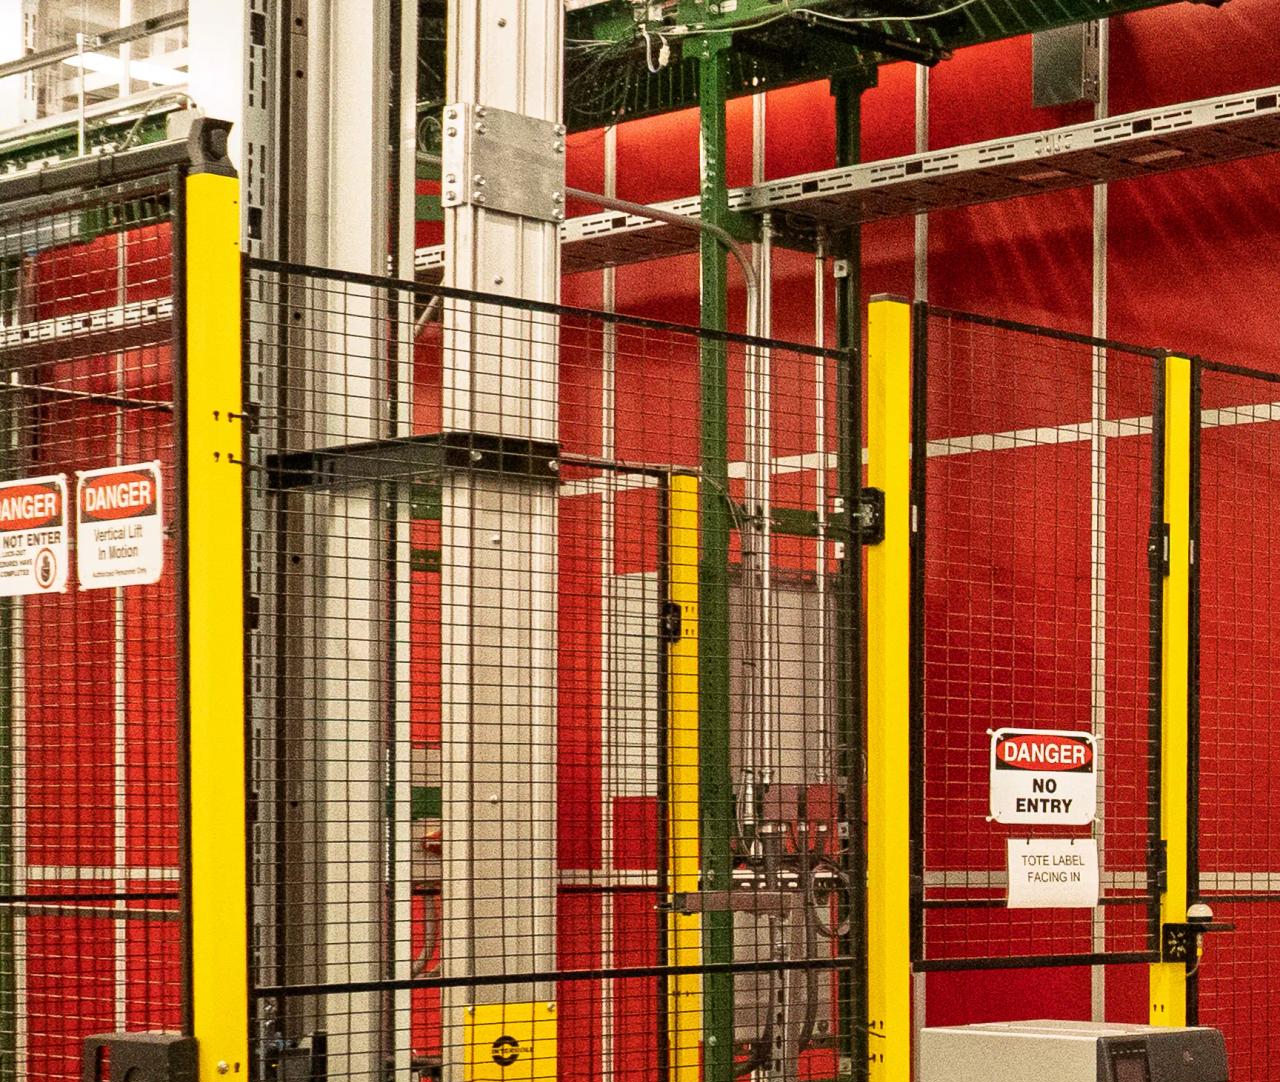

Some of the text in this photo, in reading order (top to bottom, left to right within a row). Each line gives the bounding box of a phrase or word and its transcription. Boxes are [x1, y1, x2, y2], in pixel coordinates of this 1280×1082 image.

[85, 480, 152, 512] DANGER
[0, 493, 56, 521] ANGER
[3, 531, 61, 548] NOT ENTER
[94, 524, 143, 541] Vertical Lift
[109, 545, 138, 560] Motion
[1004, 741, 1086, 765] DANGER
[1033, 778, 1057, 793] NO
[1016, 797, 1073, 813] ENTRY
[1021, 855, 1085, 866] TOTE LABEL
[1027, 871, 1081, 882] FACING IN
